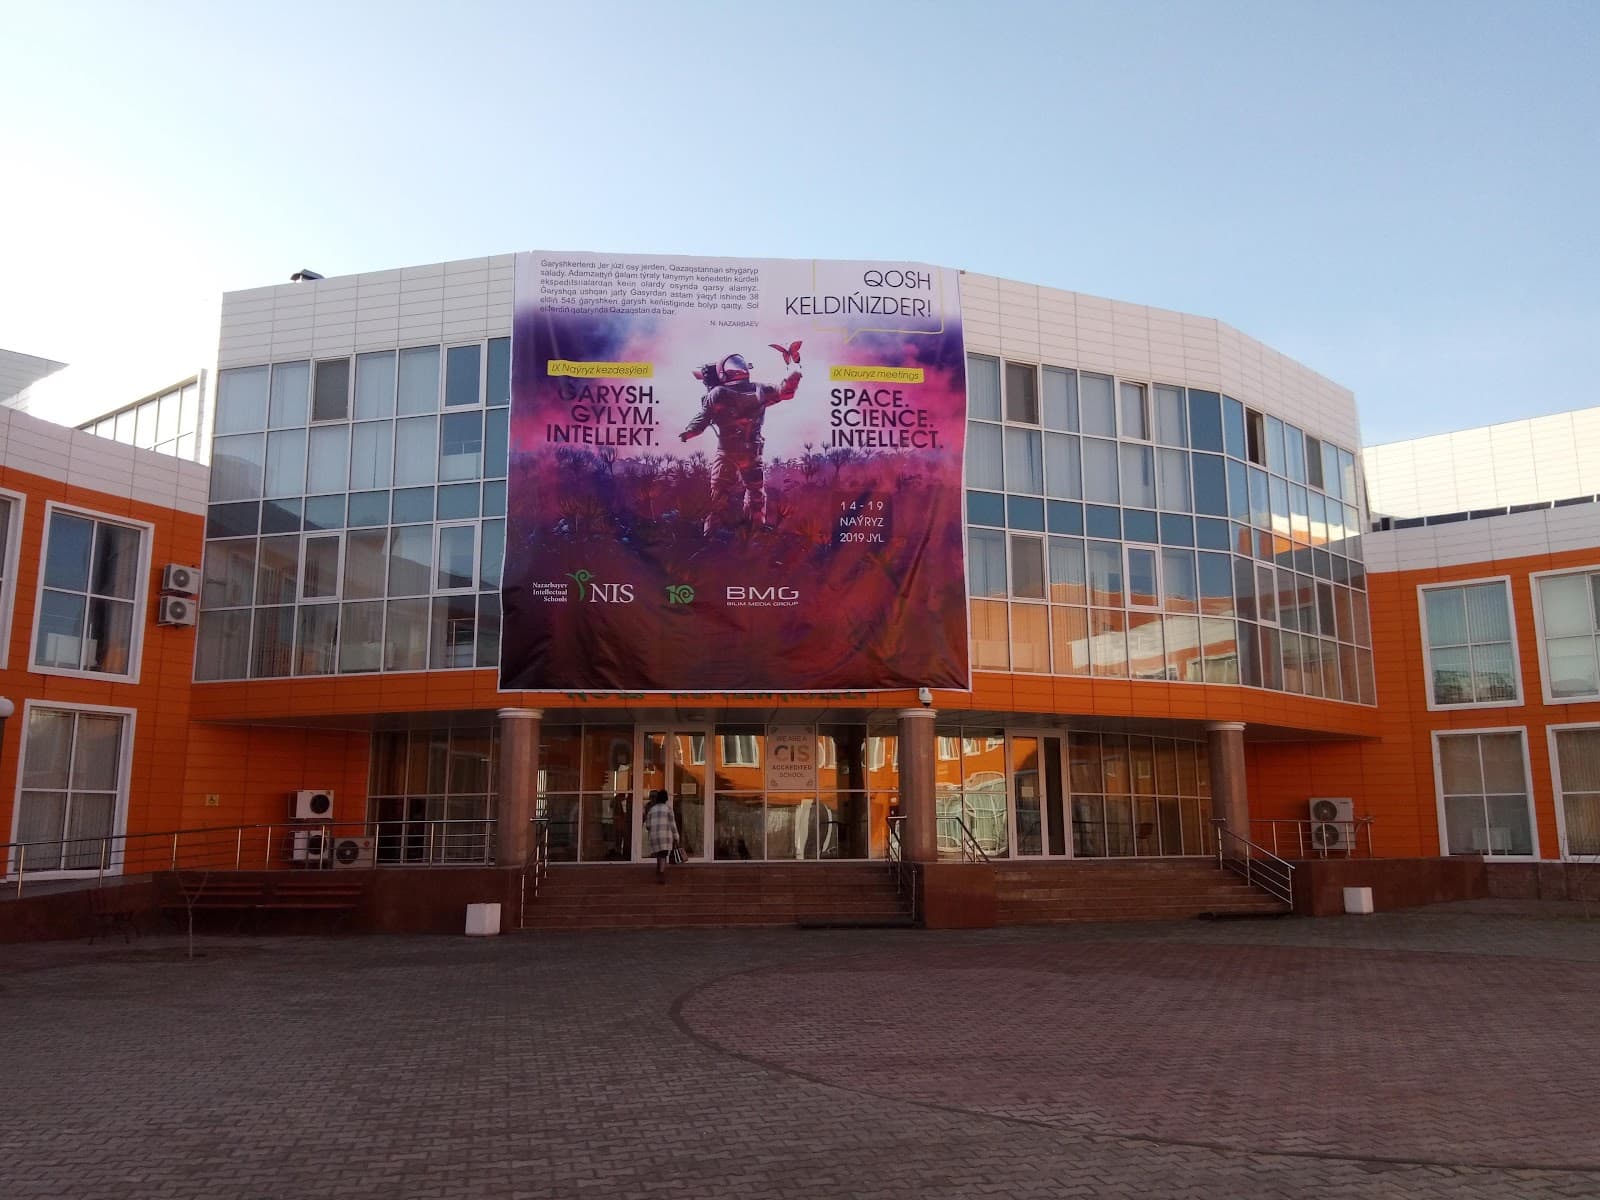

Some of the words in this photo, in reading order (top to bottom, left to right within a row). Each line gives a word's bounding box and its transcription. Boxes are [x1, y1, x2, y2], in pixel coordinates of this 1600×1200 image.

[863, 270, 931, 290] QOSH
[749, 293, 759, 301] 38
[876, 370, 920, 382] meetings
[830, 388, 910, 408] SPACE.
[830, 408, 934, 428] SCIENCE.
[546, 423, 660, 447] INTELLEKT.
[831, 428, 944, 449] INTELLECT.
[840, 532, 865, 543] 2019
[866, 532, 886, 543] JYL
[590, 583, 635, 603] NIS
[726, 586, 800, 601] BMG
[774, 744, 810, 762] CIS
